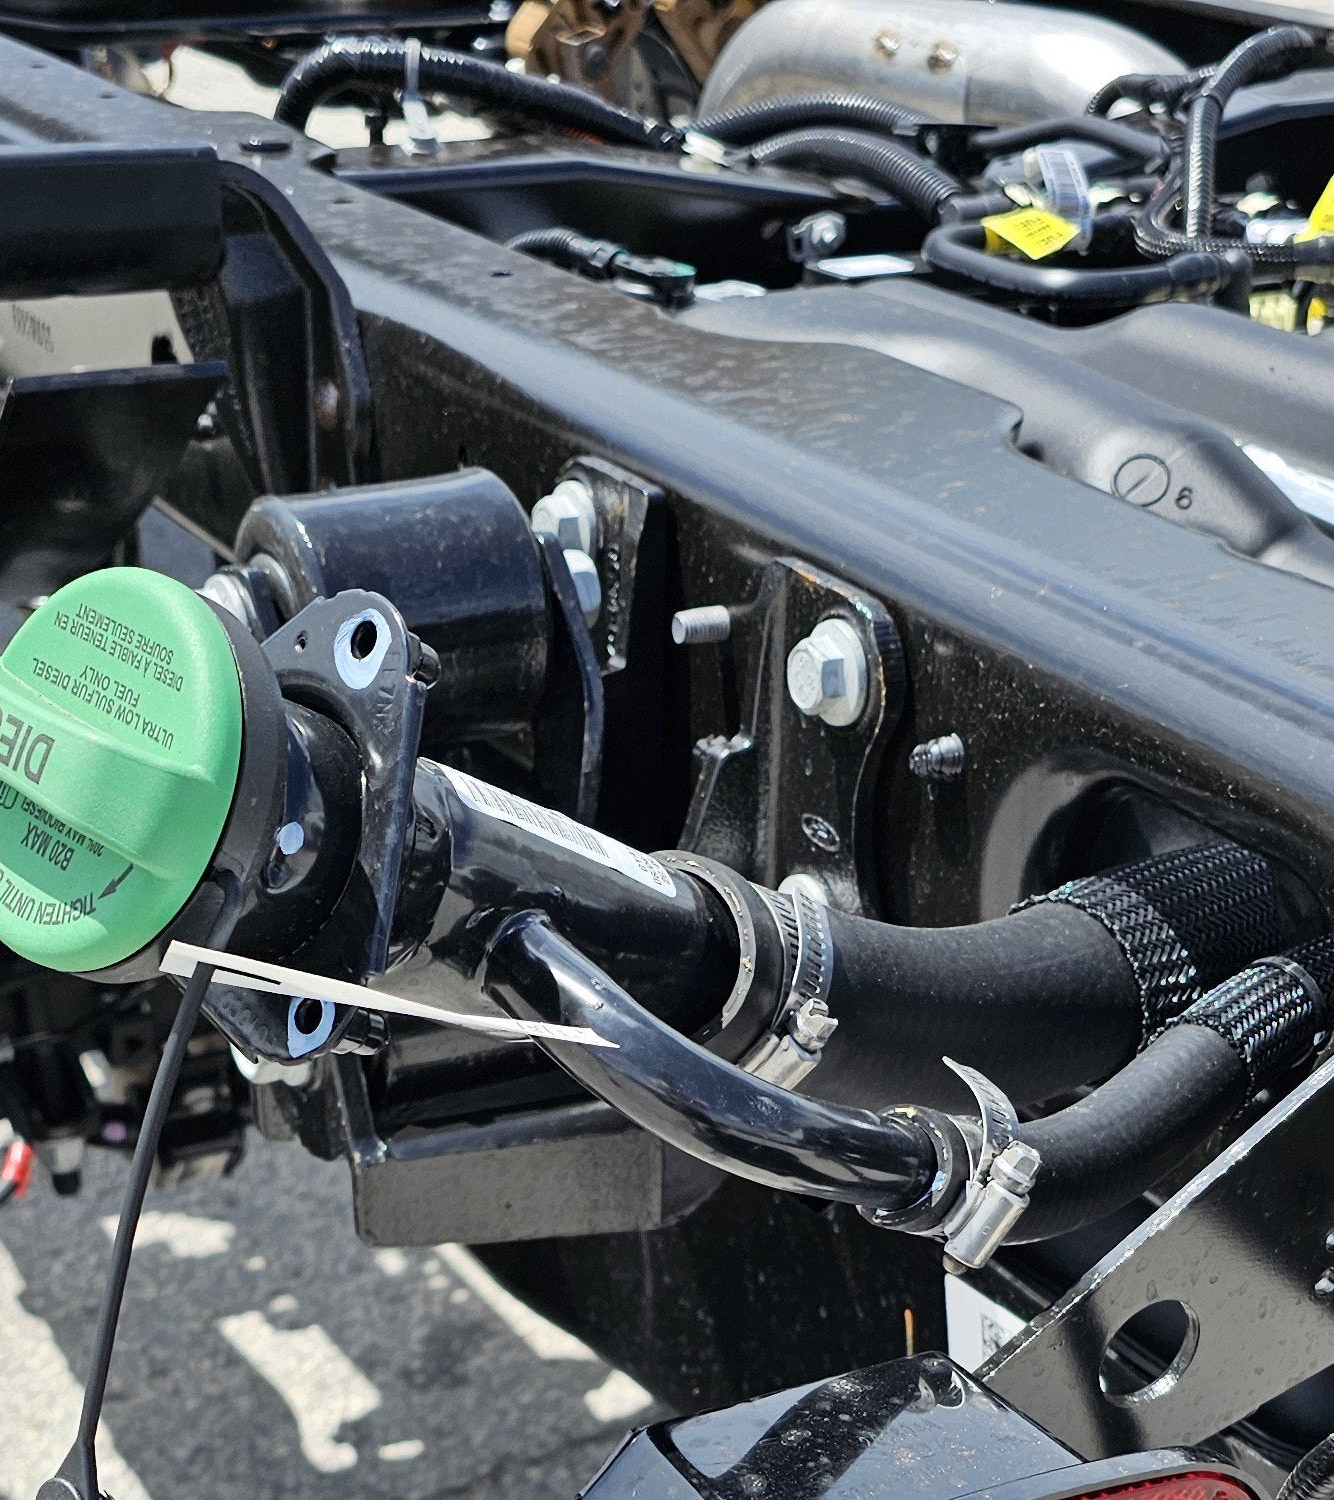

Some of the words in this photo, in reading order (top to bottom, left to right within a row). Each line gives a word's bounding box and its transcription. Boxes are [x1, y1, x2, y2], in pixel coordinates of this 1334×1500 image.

[53, 610, 70, 630] EN
[70, 618, 109, 652] TENEUR
[75, 603, 135, 645] SEULEMENT
[109, 639, 144, 670] FAIBLE
[134, 633, 174, 665] SOUFRE
[32, 658, 71, 691] DIESEL
[79, 665, 111, 691] ONLY
[143, 659, 153, 678] À
[153, 663, 184, 692] DIESEL
[71, 679, 115, 715] SULFUR
[114, 680, 141, 708] FUEL
[114, 703, 141, 730] LOW
[142, 717, 174, 750] ULTRA
[21, 822, 53, 858] MAX
[49, 840, 75, 871] B20
[0, 878, 36, 921] UNTIL
[33, 892, 96, 925] TIGHTEN
